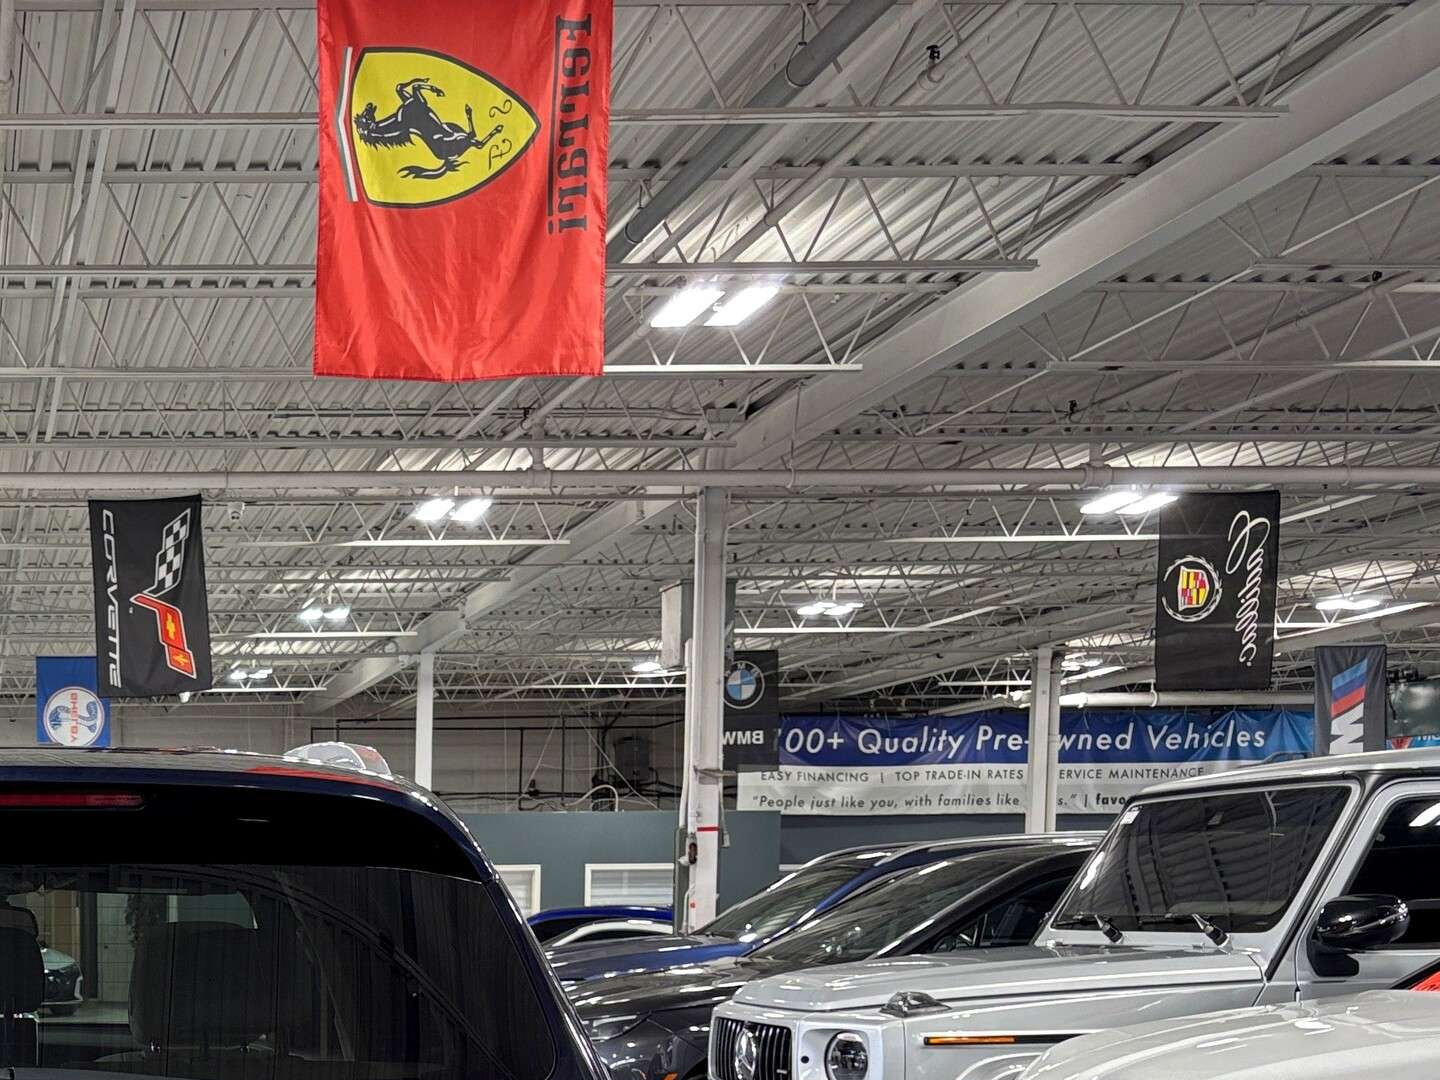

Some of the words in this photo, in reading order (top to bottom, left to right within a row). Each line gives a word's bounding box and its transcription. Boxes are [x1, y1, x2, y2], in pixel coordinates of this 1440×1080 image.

[102, 508, 122, 689] CORVETTE
[777, 727, 845, 754] 00+
[857, 725, 965, 760] Quality
[1147, 719, 1266, 751] Vehicles
[760, 771, 793, 782] EASY
[796, 771, 870, 783] FINANCING
[895, 771, 921, 783] TOP
[925, 769, 982, 781] TRADE-IN
[987, 768, 1025, 780] RATES
[1058, 768, 1103, 780] ERVICE
[1108, 766, 1205, 780] MAINTENANCE
[810, 795, 836, 811] just
[840, 795, 866, 808] like
[869, 797, 898, 811] you,
[904, 794, 932, 807] with
[937, 793, 991, 807] families
[996, 793, 1021, 807] like
